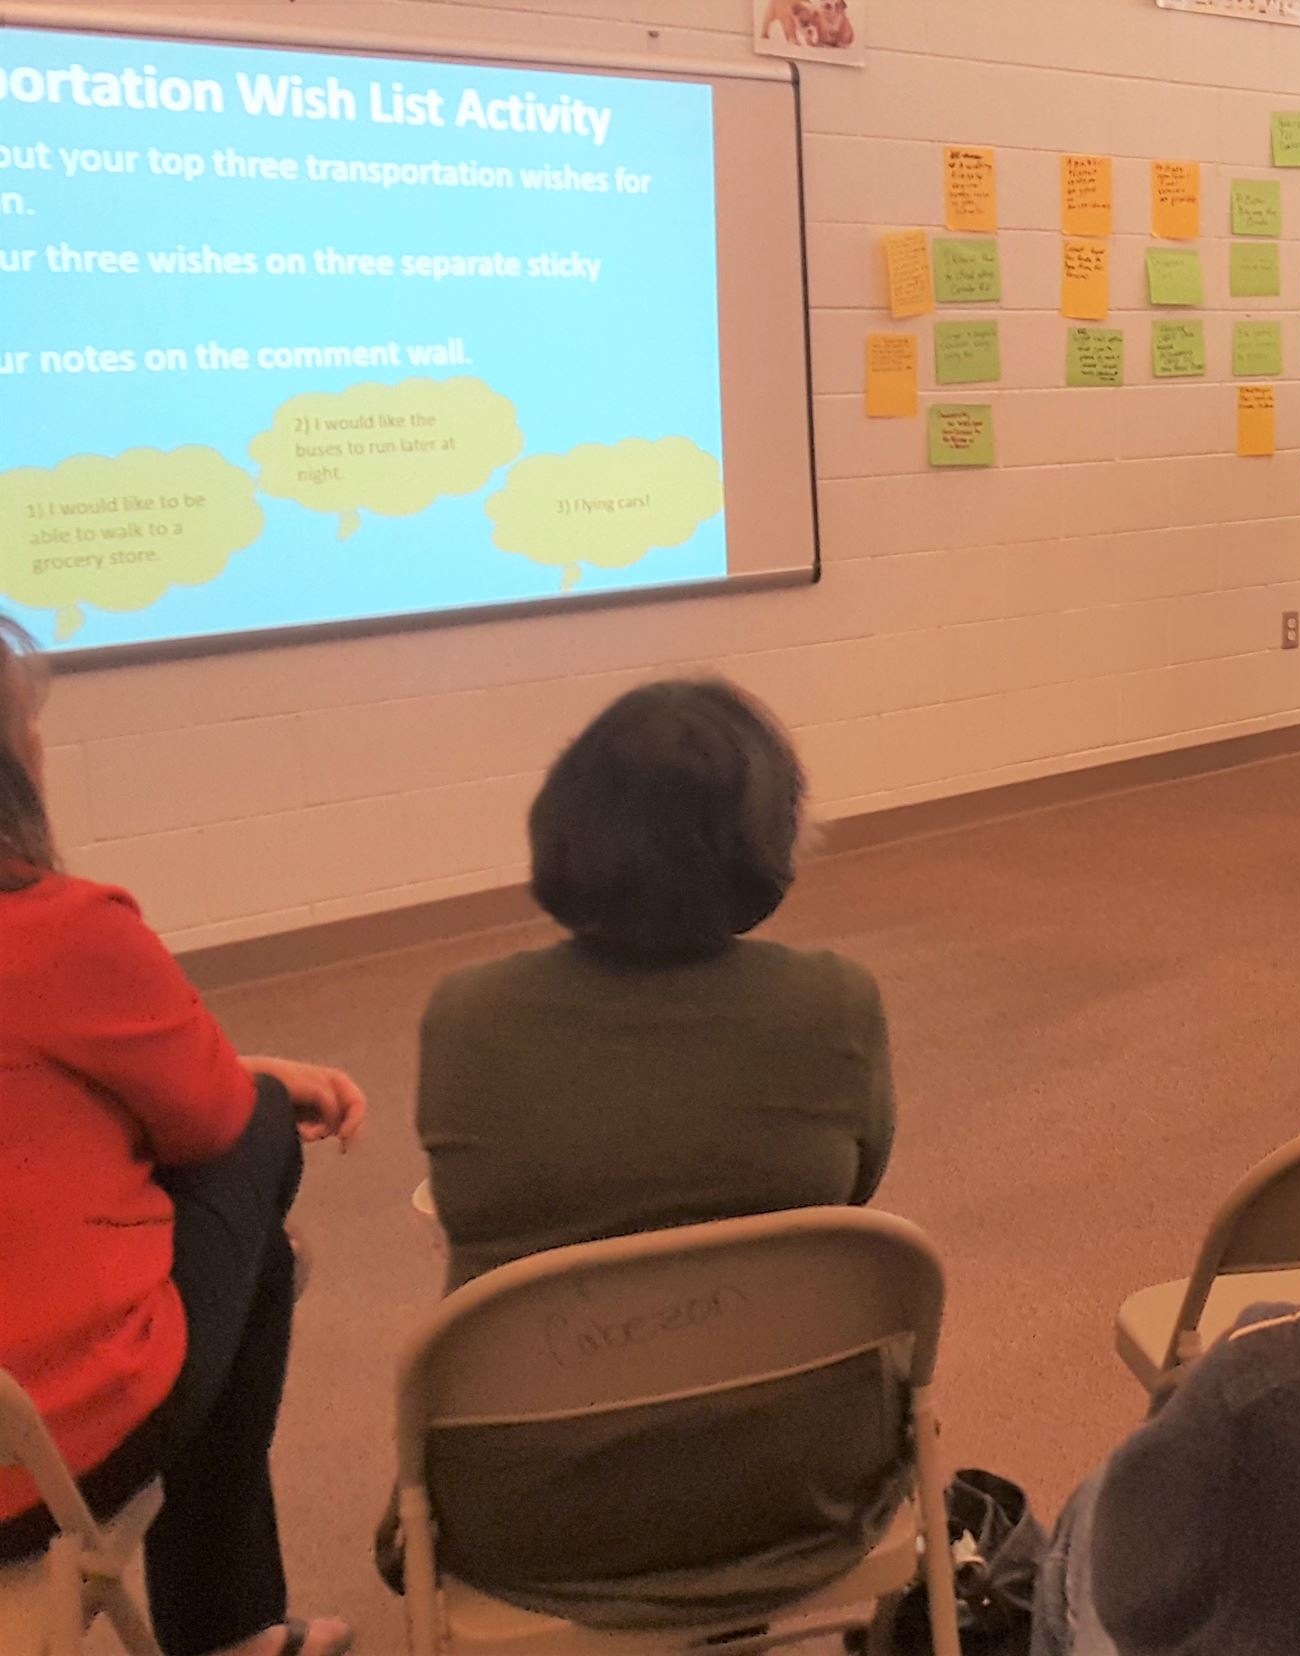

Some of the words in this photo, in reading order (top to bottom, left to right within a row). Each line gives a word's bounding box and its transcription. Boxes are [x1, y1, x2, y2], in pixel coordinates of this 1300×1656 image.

[0, 63, 224, 113] ortation
[236, 72, 356, 120] Wish
[370, 81, 445, 127] List
[455, 88, 612, 146] Activity
[59, 148, 140, 177] your
[147, 147, 205, 182] top
[212, 147, 299, 180] three
[305, 154, 513, 189] transportation
[520, 163, 608, 193] wishes
[615, 166, 652, 194] for
[45, 241, 140, 274] three
[147, 244, 258, 275] wishes
[265, 252, 306, 275] on
[313, 246, 394, 277] three
[401, 251, 521, 282] separate
[527, 250, 602, 283] sticky
[40, 345, 137, 373] notes
[144, 347, 187, 371] on
[196, 340, 249, 370] the
[257, 340, 401, 370] comment
[406, 336, 473, 366] wall.
[294, 416, 310, 436] 2)
[324, 415, 374, 431] would
[379, 414, 405, 429] like
[410, 413, 437, 427] the
[295, 442, 343, 458] buses
[347, 441, 365, 456] to
[369, 442, 396, 454] run
[400, 438, 436, 453] later
[440, 437, 456, 451] at
[27, 503, 44, 521] 1)
[60, 498, 118, 516] would
[123, 495, 155, 512] like
[159, 495, 179, 509] to
[183, 493, 207, 508] be
[556, 498, 570, 515] 3)
[28, 528, 71, 546] able
[76, 527, 97, 542] to
[100, 523, 143, 540] walk
[148, 522, 168, 536] to
[173, 522, 183, 535] a
[32, 552, 104, 576] grocery
